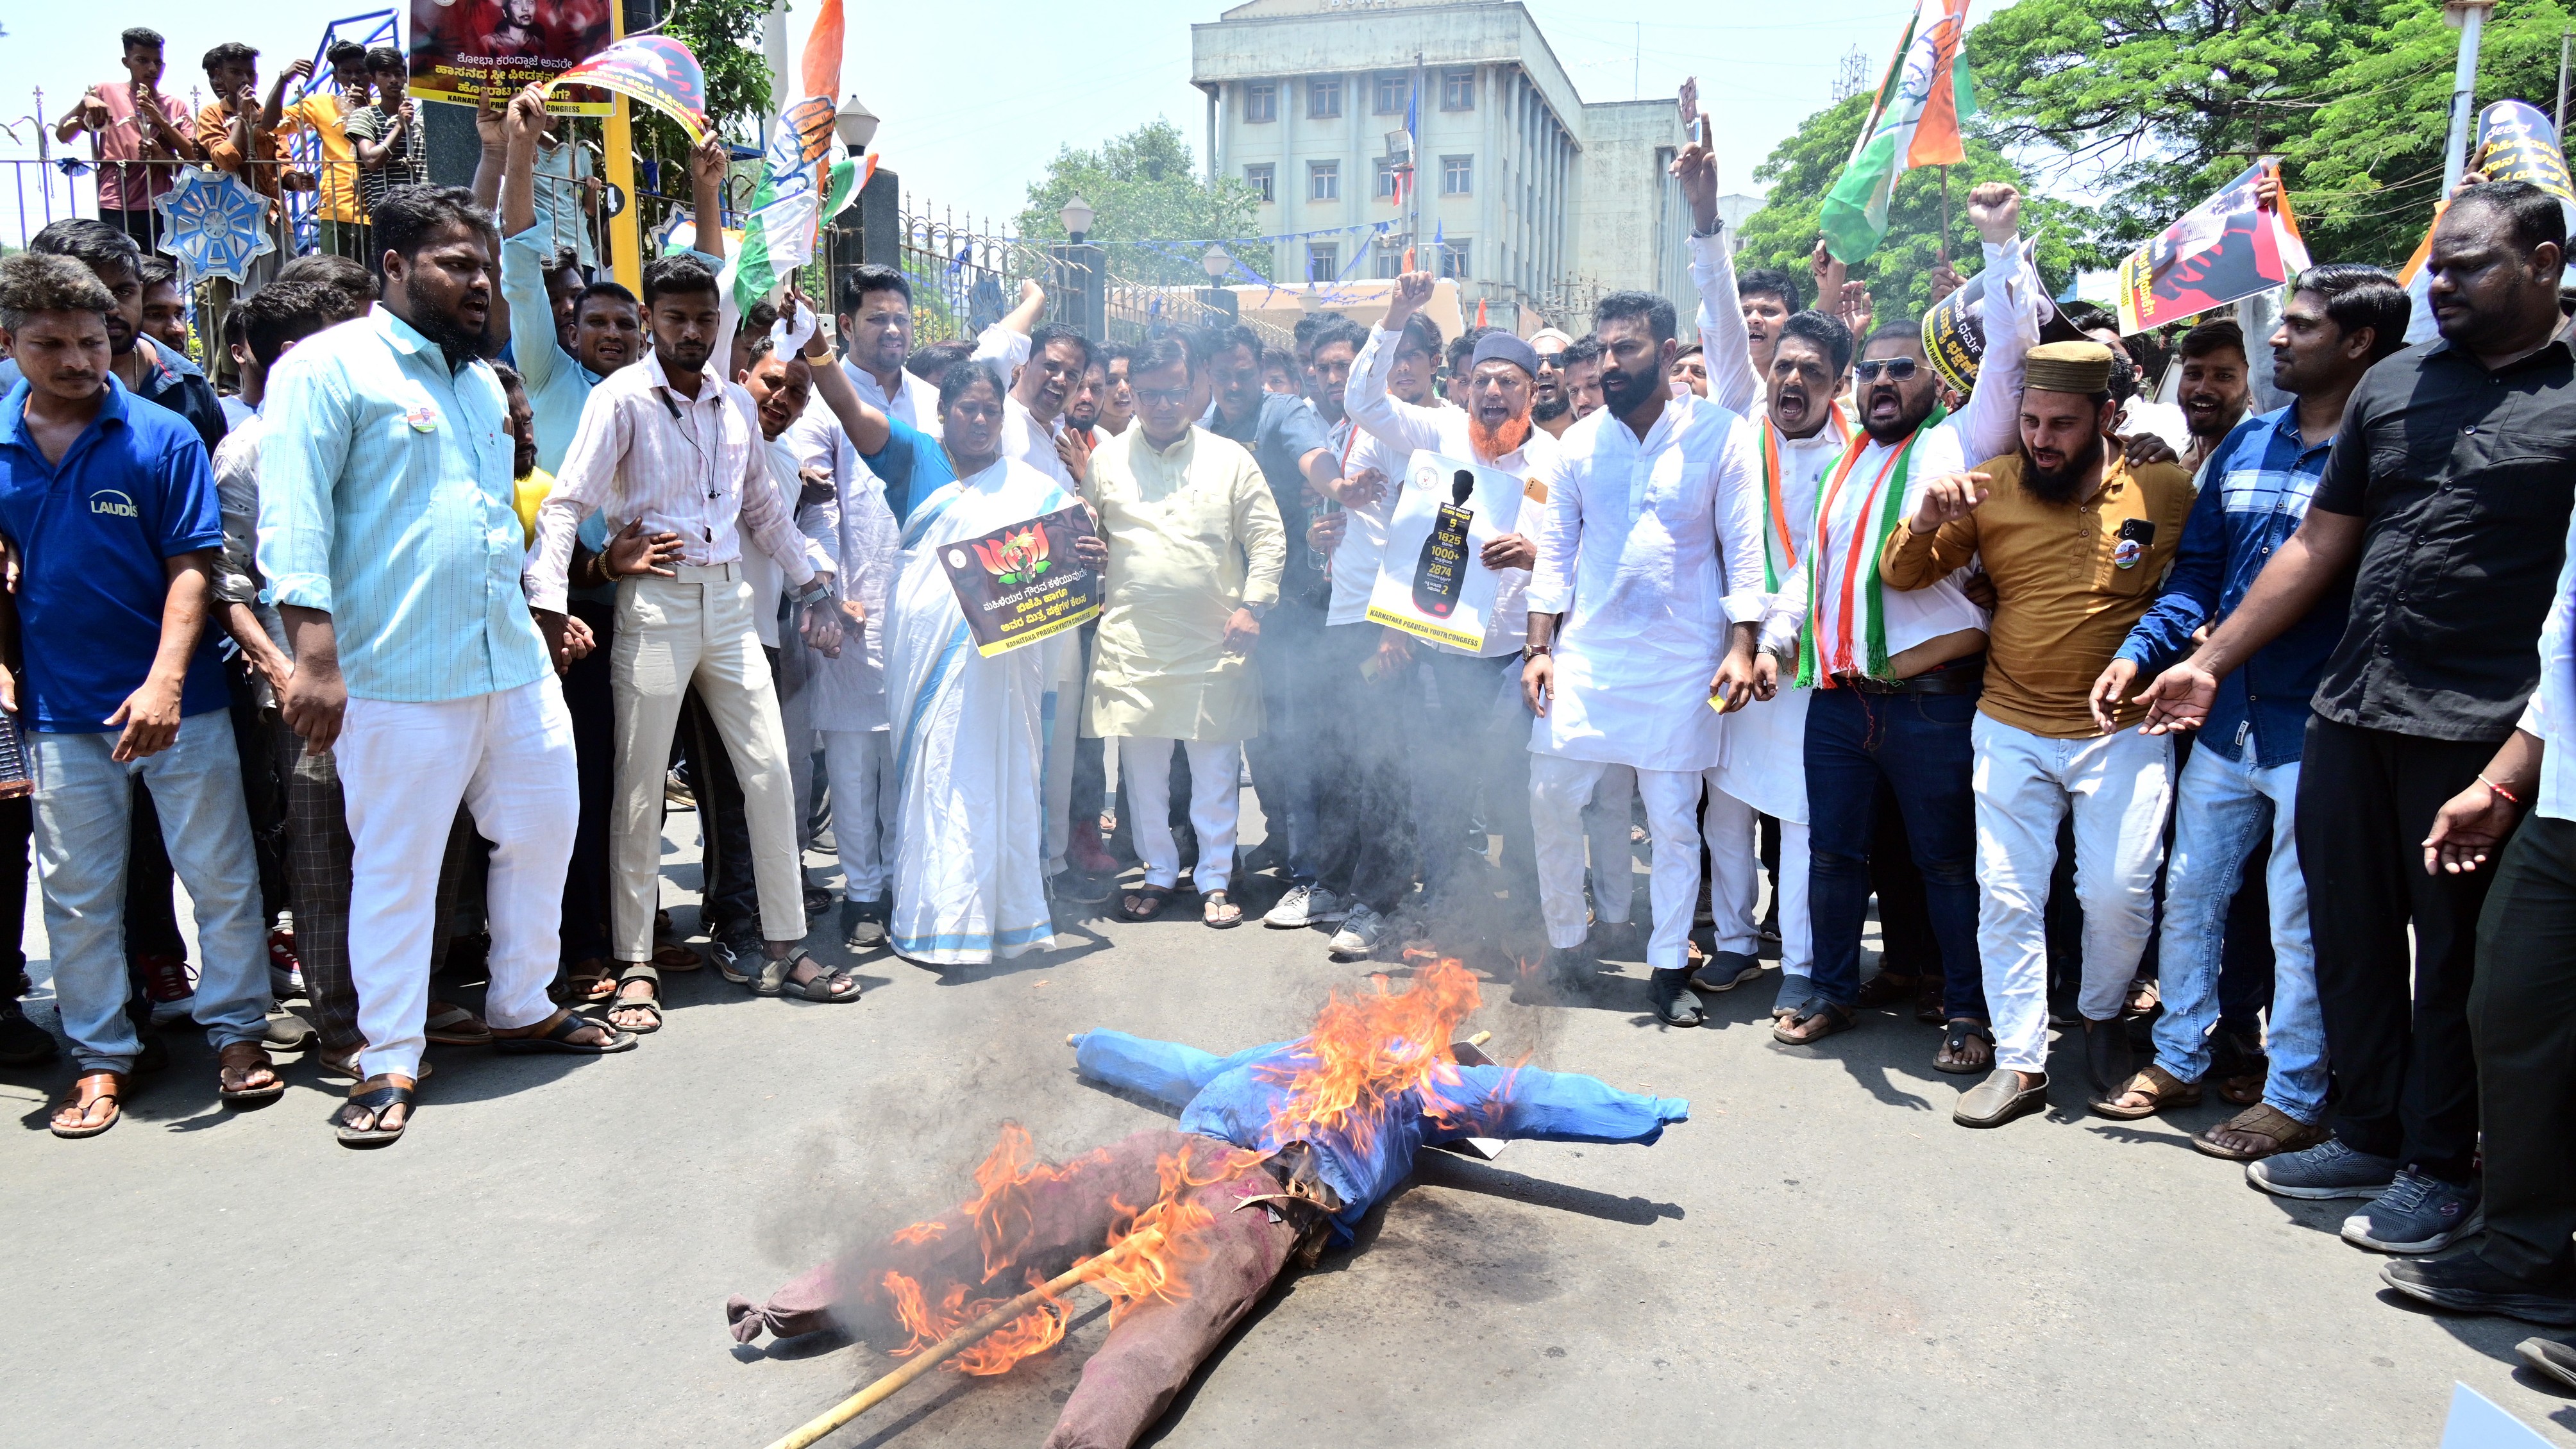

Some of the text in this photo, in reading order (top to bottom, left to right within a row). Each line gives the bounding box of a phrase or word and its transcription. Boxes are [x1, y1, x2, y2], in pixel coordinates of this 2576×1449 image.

[435, 65, 487, 80] ಹಾಸನದ
[457, 52, 572, 69] ಶೋಭಾ ಕರಂದ್ಲಾಜೆ ಅವರೇ
[448, 95, 480, 105] KARNATA
[546, 104, 580, 113] CONGRESS
[659, 103, 687, 128] CONGRESS
[1938, 306, 1954, 344] ಮಾತ್ರ
[1958, 321, 1982, 353] ಧರ್ಮ
[1928, 346, 1949, 376] PRADESH
[1946, 373, 1966, 394] YOUTH
[1449, 518, 1457, 528] 5
[1438, 532, 1461, 545] 1825
[1431, 546, 1460, 560] 1000+
[1429, 563, 1452, 577] 2874
[983, 567, 1087, 612] ಮಹಿಳೆಯರ ಗೌರವ ಕಳೆಯುವುದೇ
[1016, 588, 1068, 614] ಬಿಜೆಪಿ ಹಾಗೂ
[1441, 585, 1449, 595] 2
[1000, 593, 1087, 632] ಅವರ ಮಿತ್ರ ಪಕ್ಷಗಳ ಕೆಲಸ
[1006, 612, 1090, 649] KARNATAKA PRADESH YOUTH CONGRESS
[1369, 609, 1479, 648] KARNATAKA PRADESH YOUTH CONGRESS
